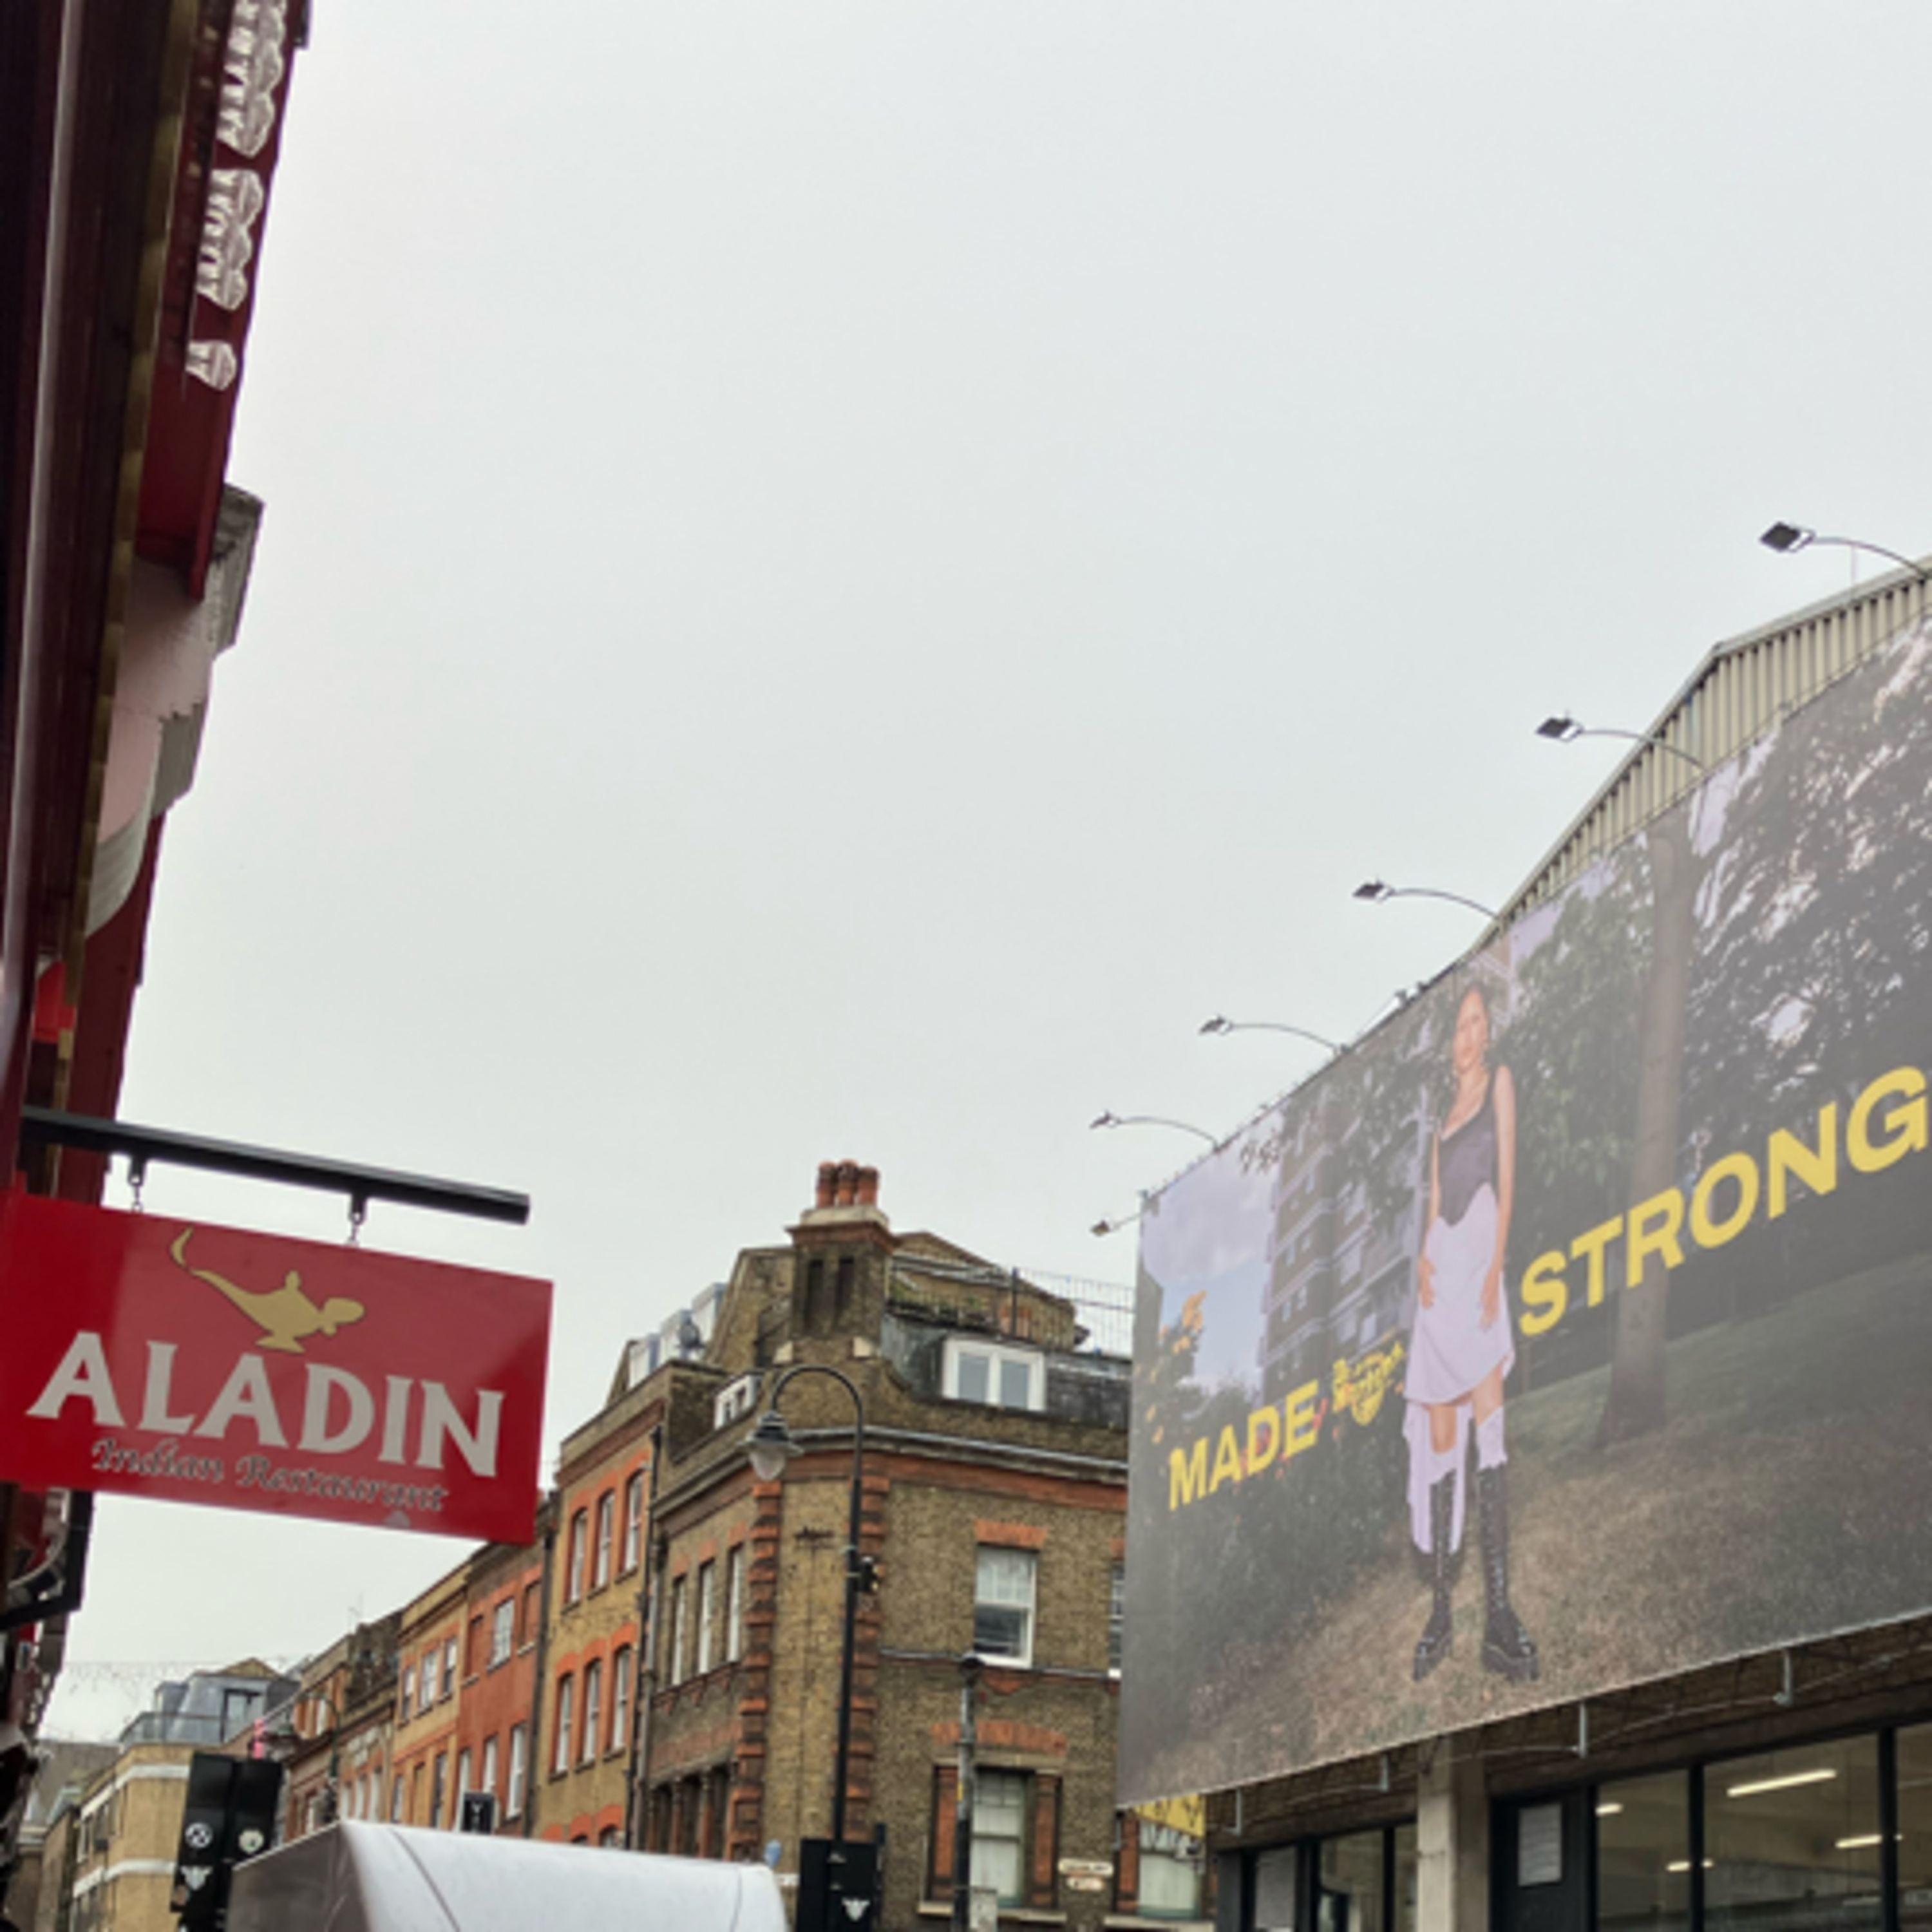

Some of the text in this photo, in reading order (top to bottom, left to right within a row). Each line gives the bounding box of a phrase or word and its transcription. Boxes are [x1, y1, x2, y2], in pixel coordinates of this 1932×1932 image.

[1168, 1379, 1319, 1511] MADE
[1519, 1066, 1928, 1337] STRONG
[26, 1331, 504, 1477] ALADIN
[92, 1437, 449, 1511] Indian Restaurant
